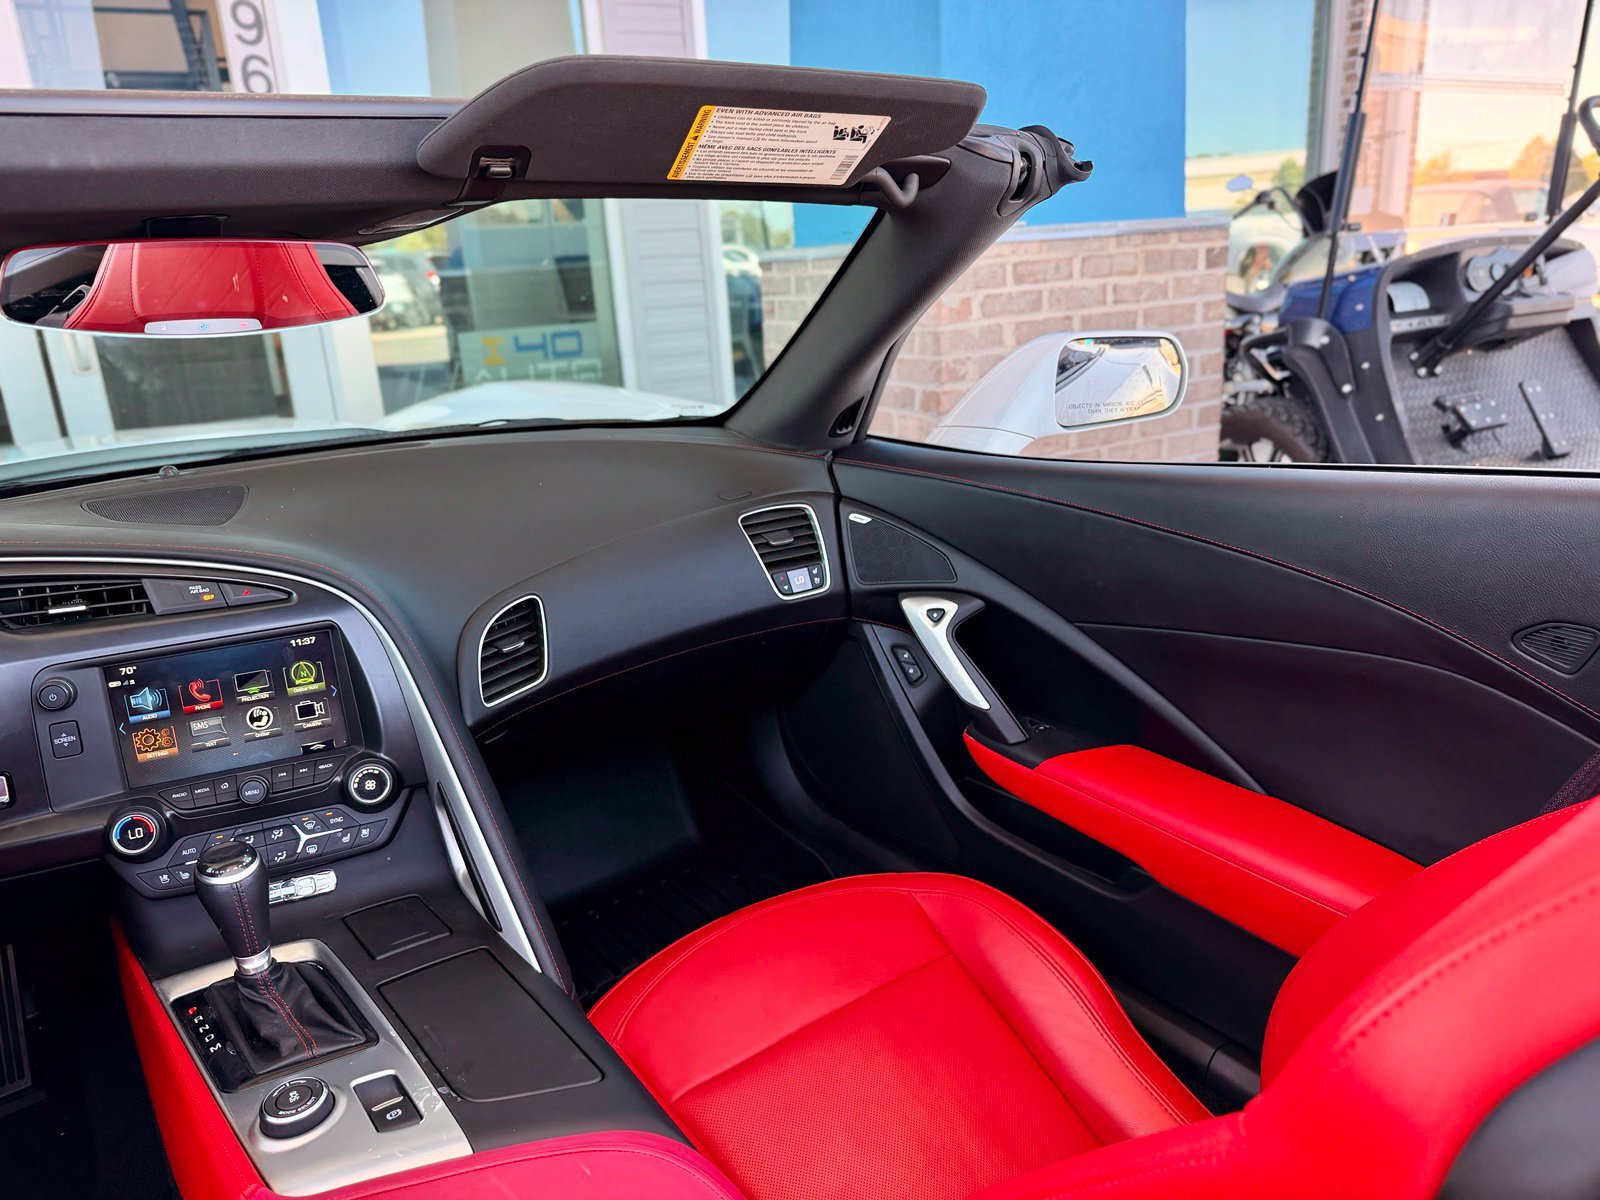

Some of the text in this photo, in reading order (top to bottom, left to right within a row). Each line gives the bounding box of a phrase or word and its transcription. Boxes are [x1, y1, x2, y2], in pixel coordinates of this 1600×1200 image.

[716, 107, 735, 115] EVEN
[735, 108, 753, 116] WITH
[753, 109, 790, 117] ADVANCED
[693, 109, 712, 133] WARNING
[513, 330, 584, 359] 40
[290, 635, 316, 647] 11:37
[192, 721, 209, 731] SMS
[53, 735, 76, 745] SCREEN
[194, 786, 210, 795] MEDIA
[245, 788, 260, 797] MENU
[329, 816, 344, 824] SYNC
[182, 847, 197, 856] AUTO
